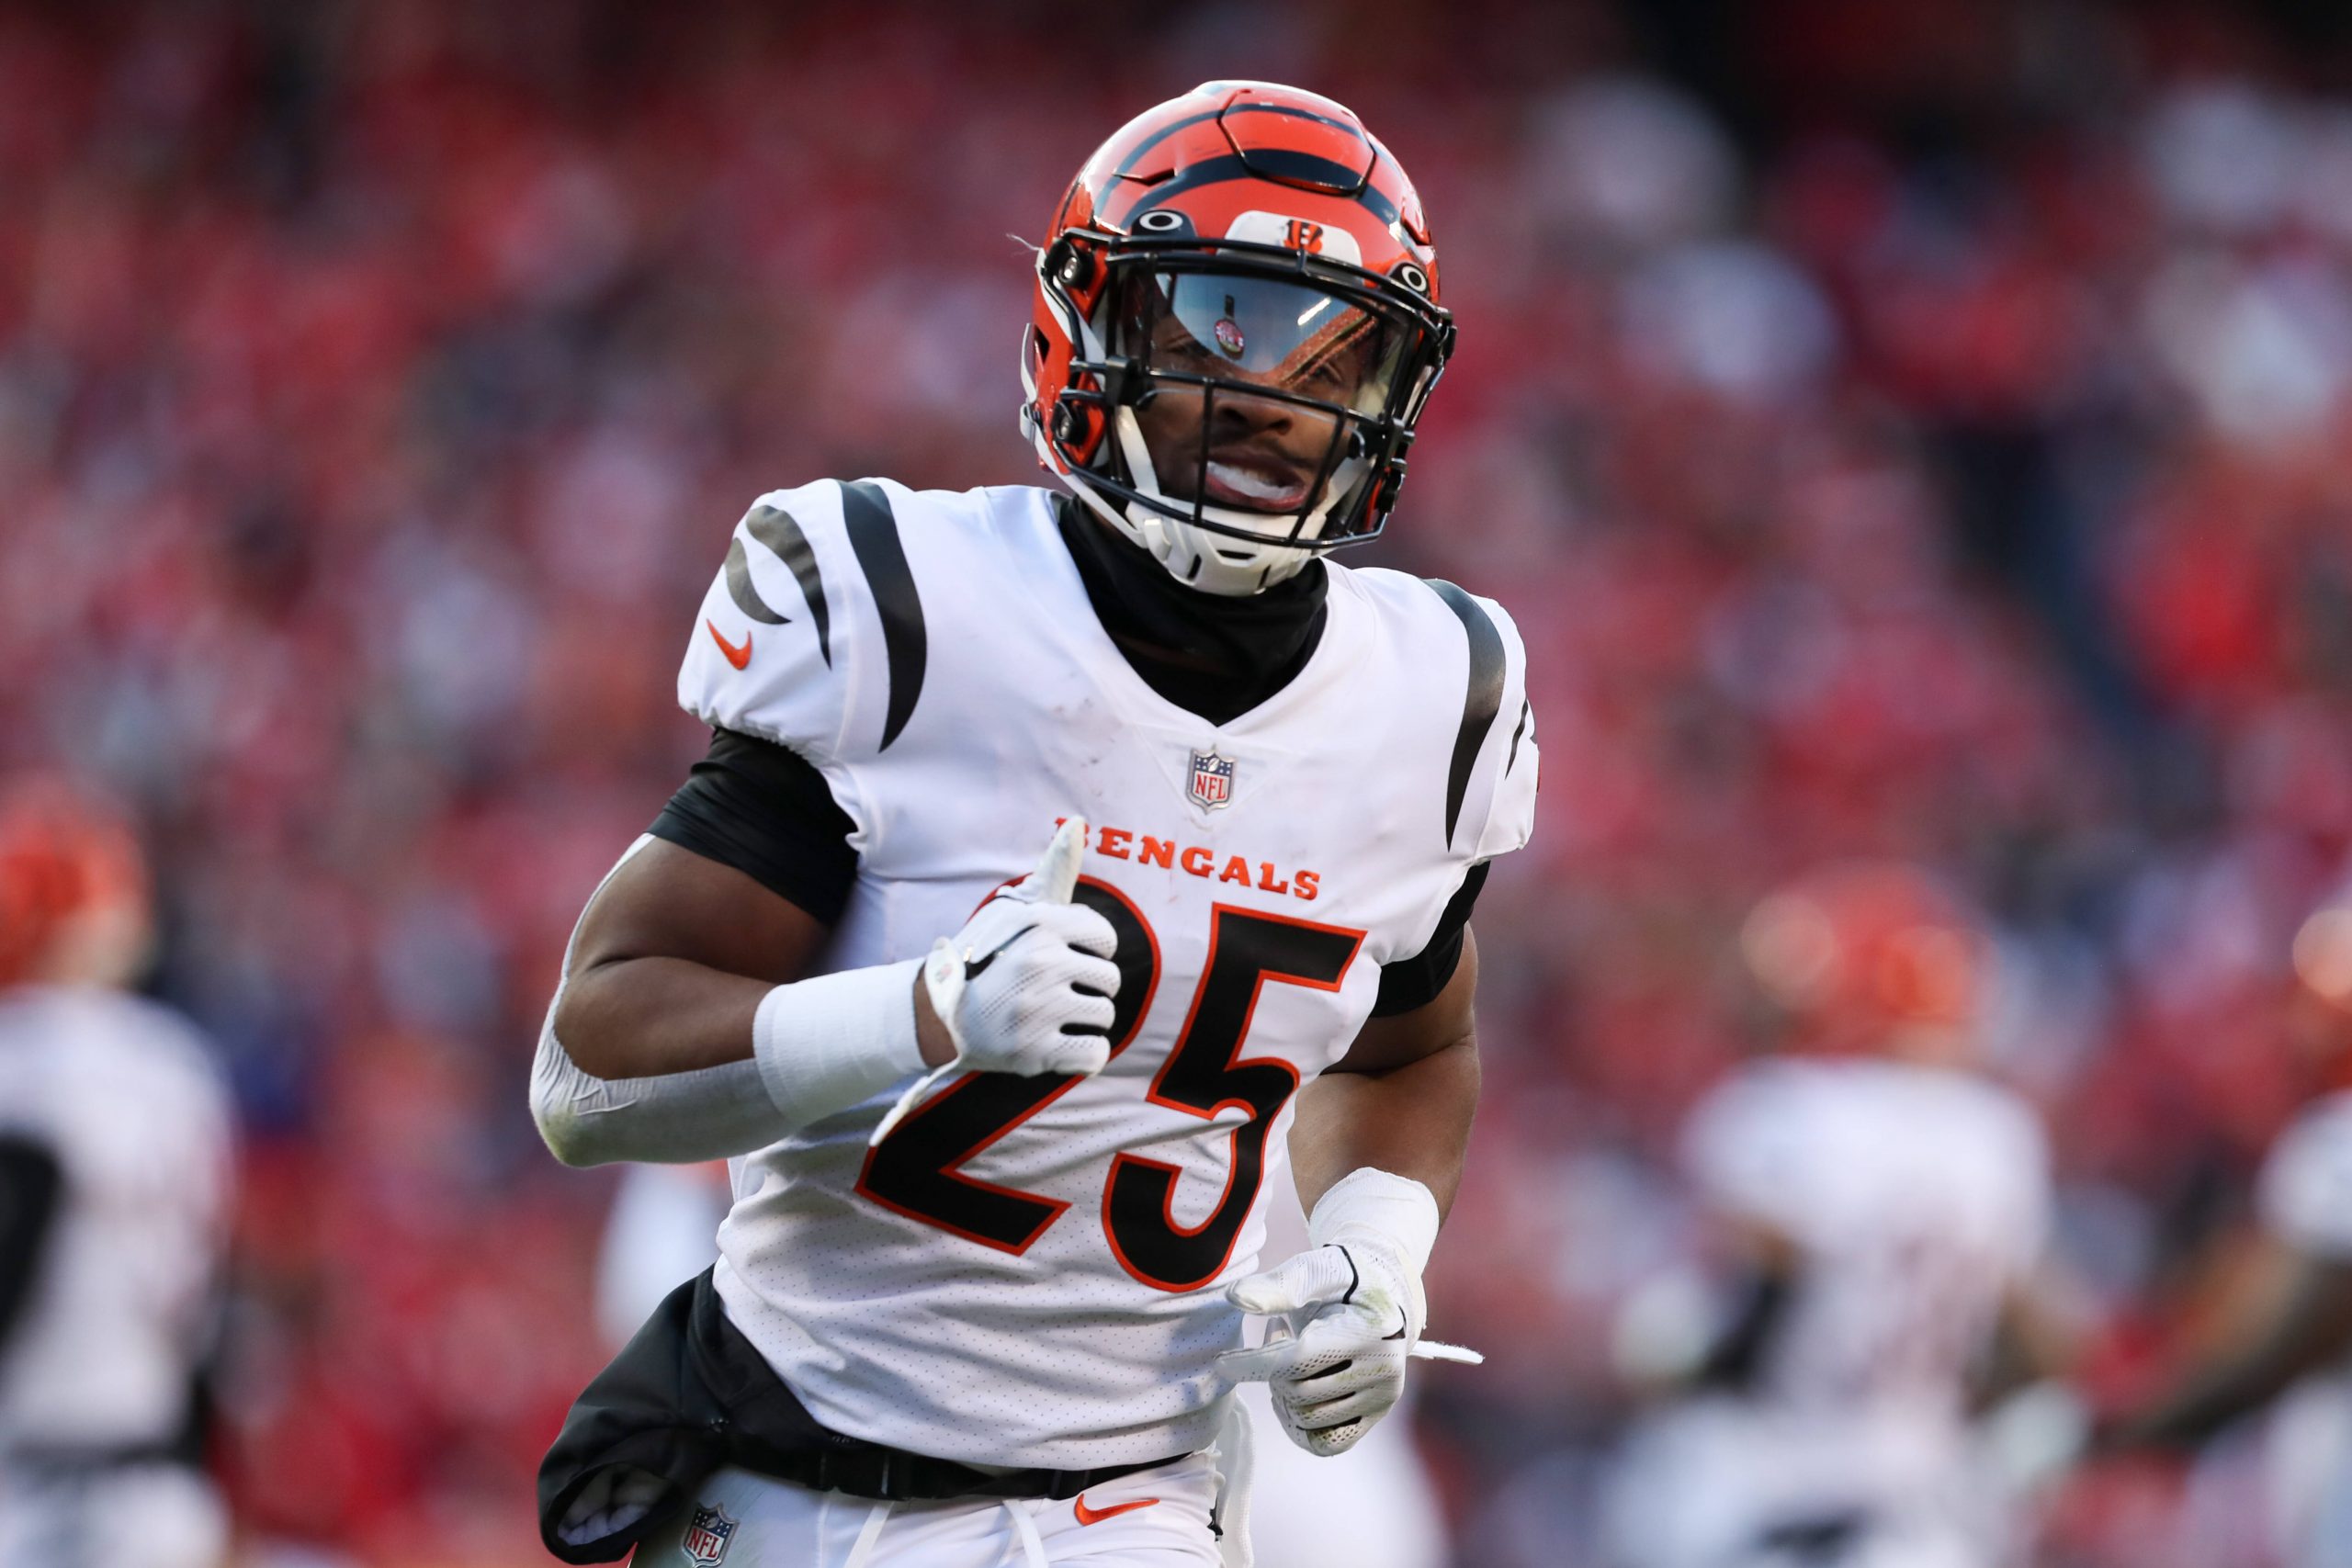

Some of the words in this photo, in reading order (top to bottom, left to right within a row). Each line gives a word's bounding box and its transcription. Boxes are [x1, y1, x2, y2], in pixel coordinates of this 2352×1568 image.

[1195, 773, 1227, 801] NFL
[854, 873, 1368, 1292] 25
[687, 1528, 719, 1558] NFL
